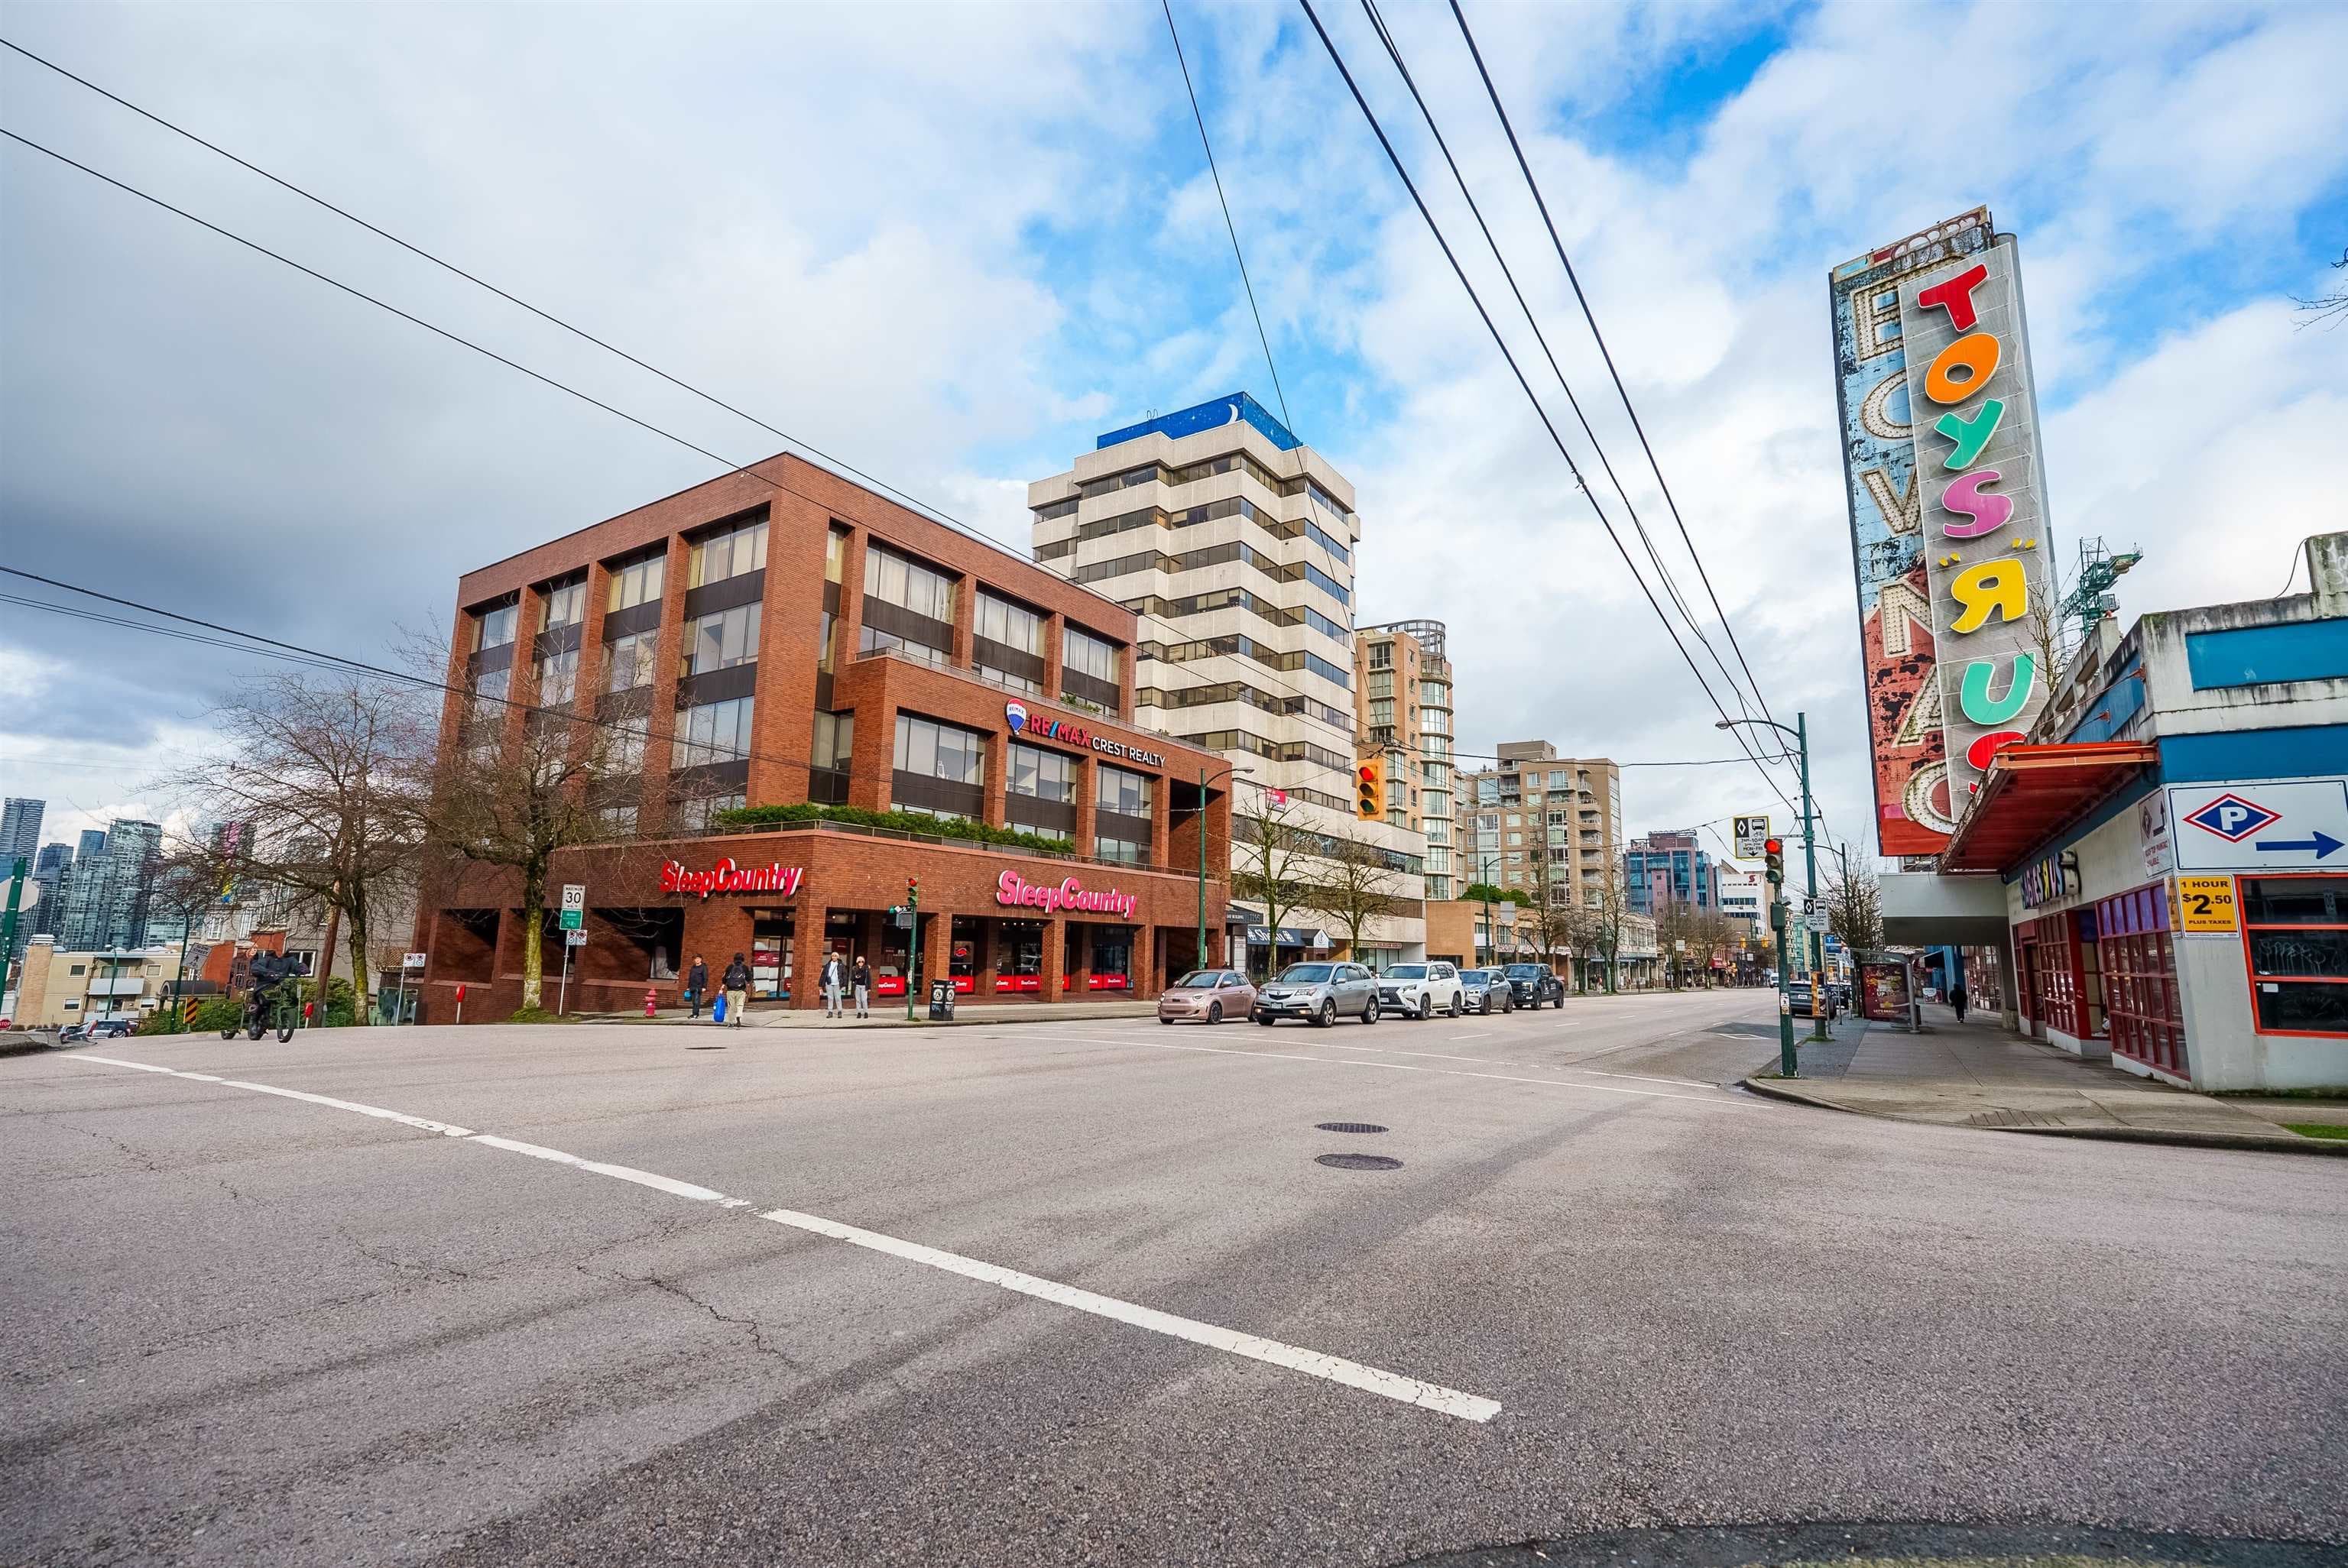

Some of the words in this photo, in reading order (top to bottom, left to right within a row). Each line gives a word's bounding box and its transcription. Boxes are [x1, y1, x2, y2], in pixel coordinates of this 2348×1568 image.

[1917, 263, 2016, 539] TOYS
[1030, 714, 1091, 747] RE/MAX
[1092, 737, 1127, 757] CREST
[1128, 747, 1166, 768] REALTY
[2219, 806, 2248, 831] P
[565, 892, 582, 904] 30
